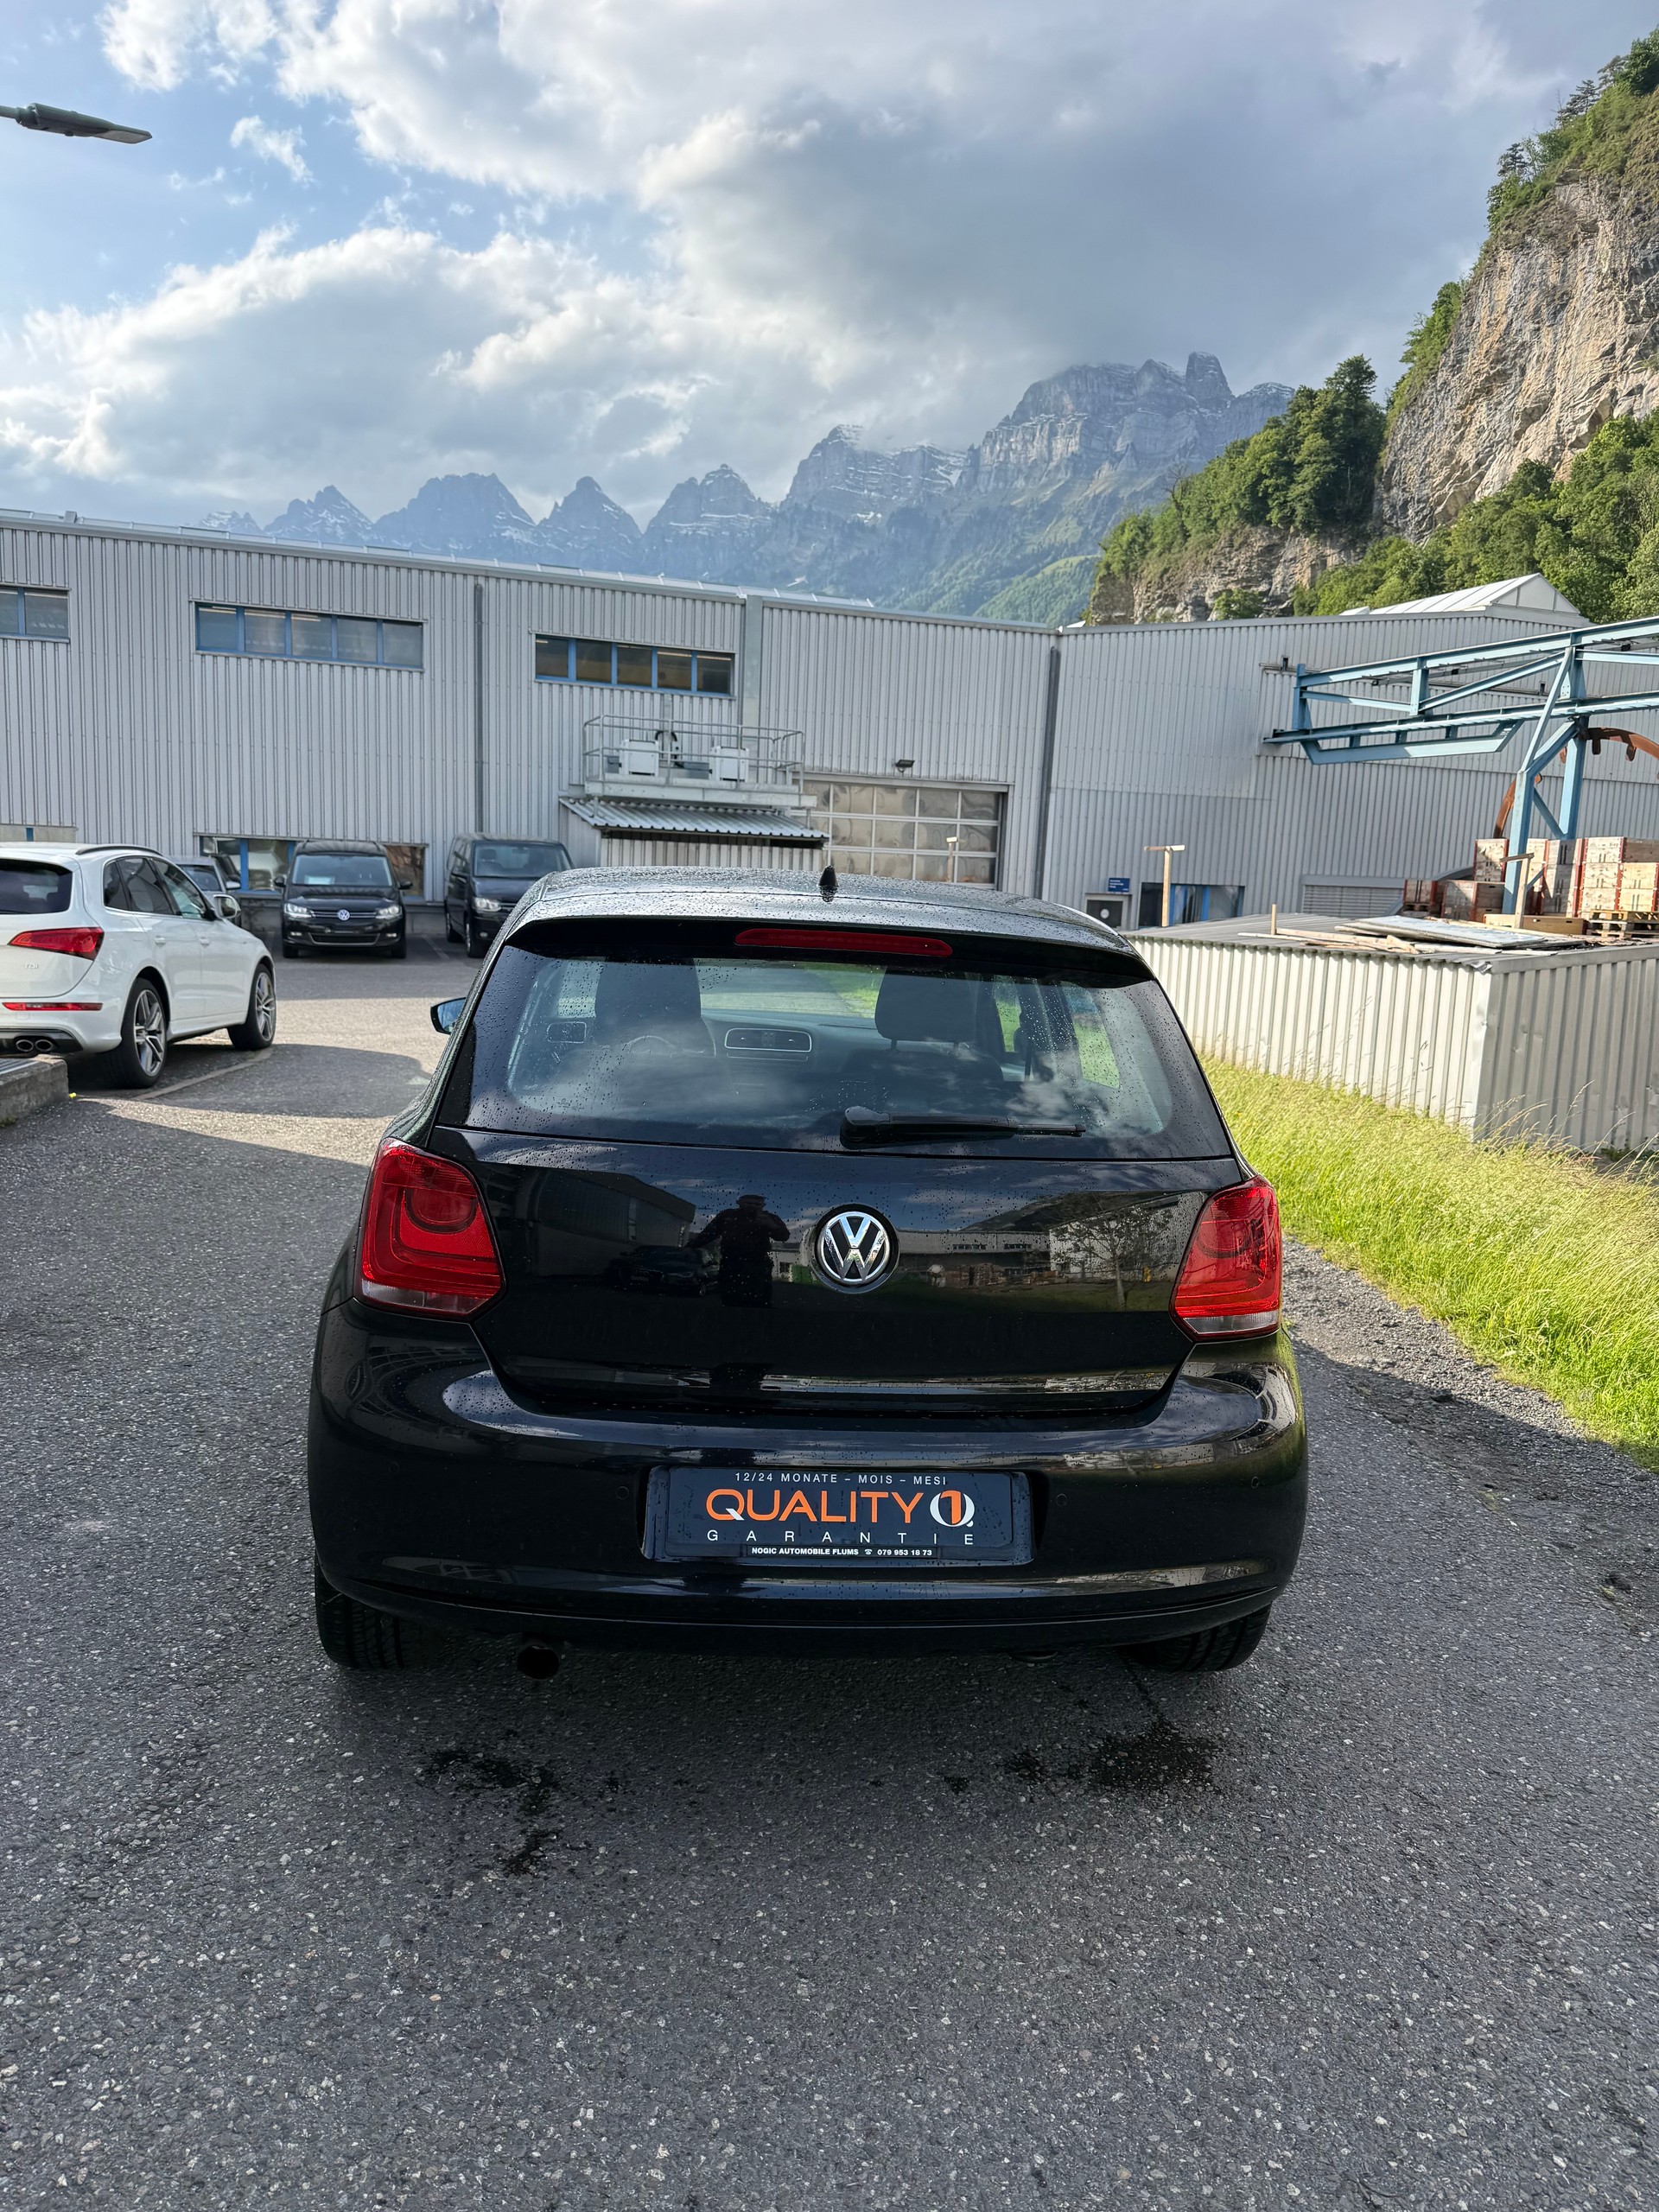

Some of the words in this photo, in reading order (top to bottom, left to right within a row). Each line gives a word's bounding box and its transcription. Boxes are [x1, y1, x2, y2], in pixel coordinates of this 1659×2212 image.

[818, 1211, 889, 1284] VW
[734, 1472, 773, 1482] 12/24
[780, 1472, 838, 1484] MONATE
[858, 1474, 893, 1484] MOIS
[913, 1476, 946, 1485] MESI
[705, 1488, 925, 1524] QUALITY
[707, 1529, 974, 1545] GARANTIE
